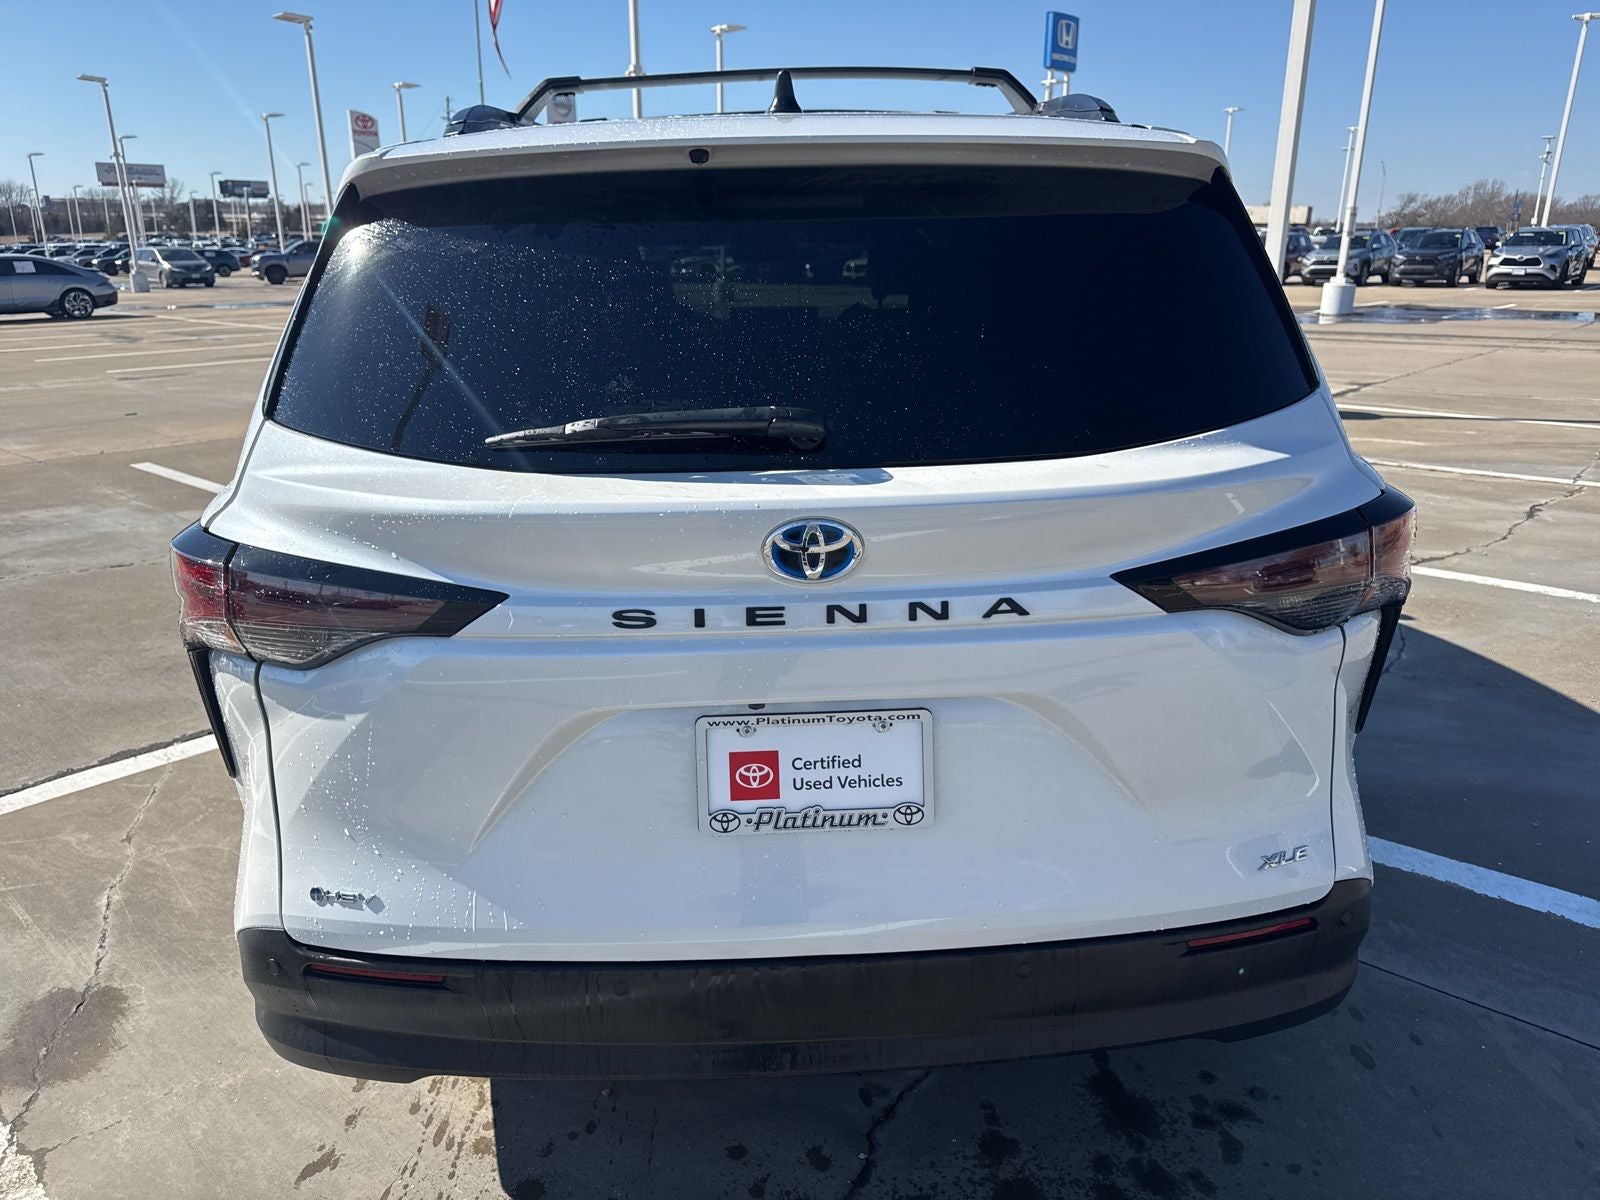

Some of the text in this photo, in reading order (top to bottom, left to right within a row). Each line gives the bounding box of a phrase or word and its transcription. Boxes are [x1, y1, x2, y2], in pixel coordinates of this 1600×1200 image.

[612, 597, 1031, 630] SIENNA
[707, 713, 921, 727] www.PlatinumToyota.com
[791, 754, 862, 771] Certified
[793, 773, 903, 791] Used Vehicles
[754, 808, 885, 832] Platinum
[1257, 845, 1308, 870] XLE
